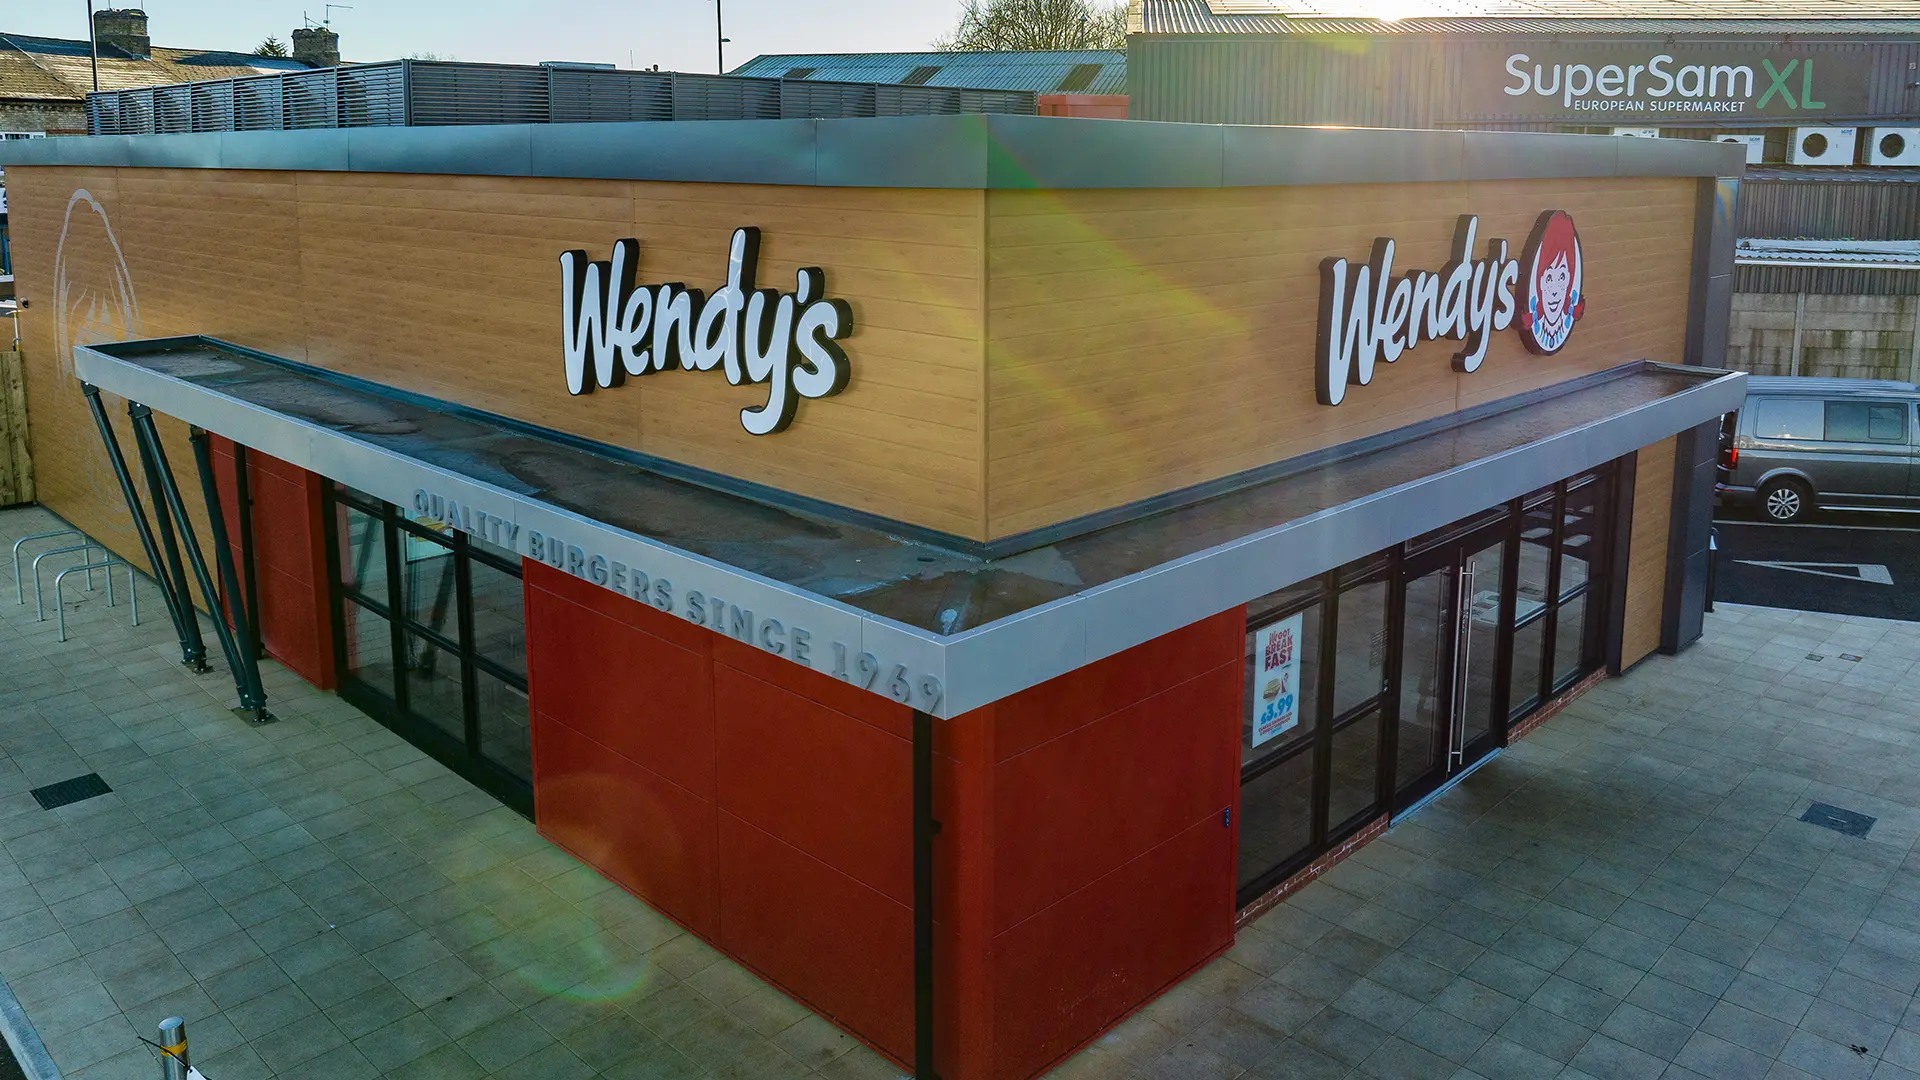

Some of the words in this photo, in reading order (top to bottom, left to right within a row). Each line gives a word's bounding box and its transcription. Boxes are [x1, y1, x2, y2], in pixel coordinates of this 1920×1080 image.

[1504, 53, 1754, 108] SuperSam
[1756, 58, 1827, 110] XL
[1574, 99, 1645, 112] EUROPEAN
[1650, 100, 1745, 113] SUPERMARKET
[559, 226, 853, 435] Wendy's
[1315, 214, 1519, 406] Wendy's
[412, 488, 520, 550] QUALITY
[528, 530, 675, 613] BURGERS
[686, 590, 811, 667] SINCE
[831, 641, 943, 715] 1969
[1264, 646, 1293, 673] FAST
[1265, 635, 1294, 657] BREAK
[1260, 694, 1294, 725] £3.99
